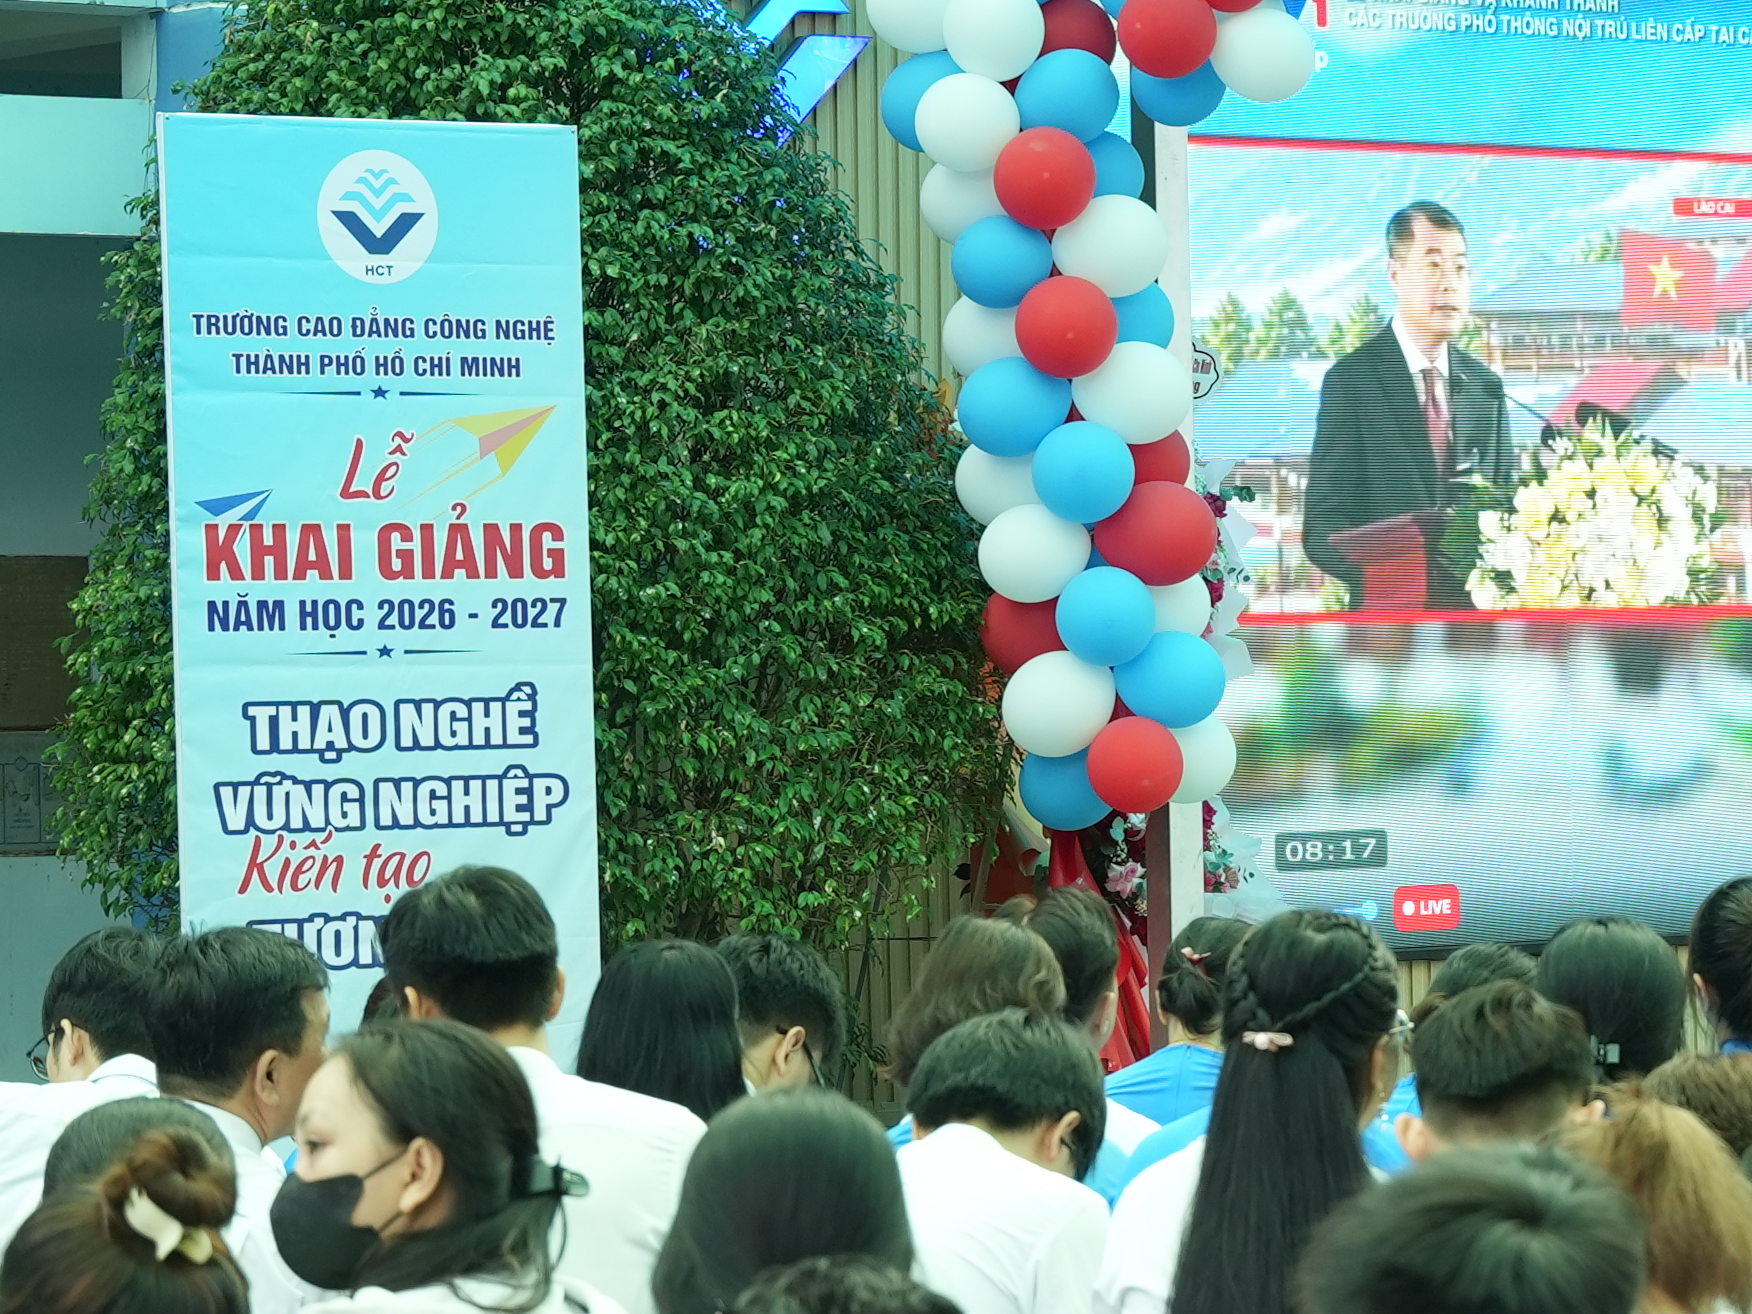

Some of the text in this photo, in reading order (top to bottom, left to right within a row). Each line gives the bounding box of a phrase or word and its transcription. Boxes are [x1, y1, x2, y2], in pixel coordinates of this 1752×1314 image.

[1347, 8, 1381, 29] CÁC
[1502, 12, 1558, 37] THÔNG
[1562, 15, 1592, 41] NỘI
[1631, 17, 1668, 42] LIÊN
[1672, 17, 1705, 43] CẤP
[1709, 24, 1735, 48] TẠI
[364, 264, 394, 278] HCT
[192, 306, 556, 347] TRƯỜNG CAO ĐẲNG CÔNG NGHỆ
[231, 346, 521, 379] THÀNH PHỐ HỒ CHÍ MINH
[339, 430, 415, 501] Lễ
[203, 502, 567, 583] KHAI GIẢNG
[206, 591, 568, 639] NĂM HỌC 2026 2027
[244, 682, 539, 762] THẠO NGHỀ
[214, 763, 569, 836] VỮNG NGHIỆP
[237, 829, 432, 904] Kiến tạo
[1285, 837, 1377, 862] 08:17
[1419, 898, 1452, 916] LIVE
